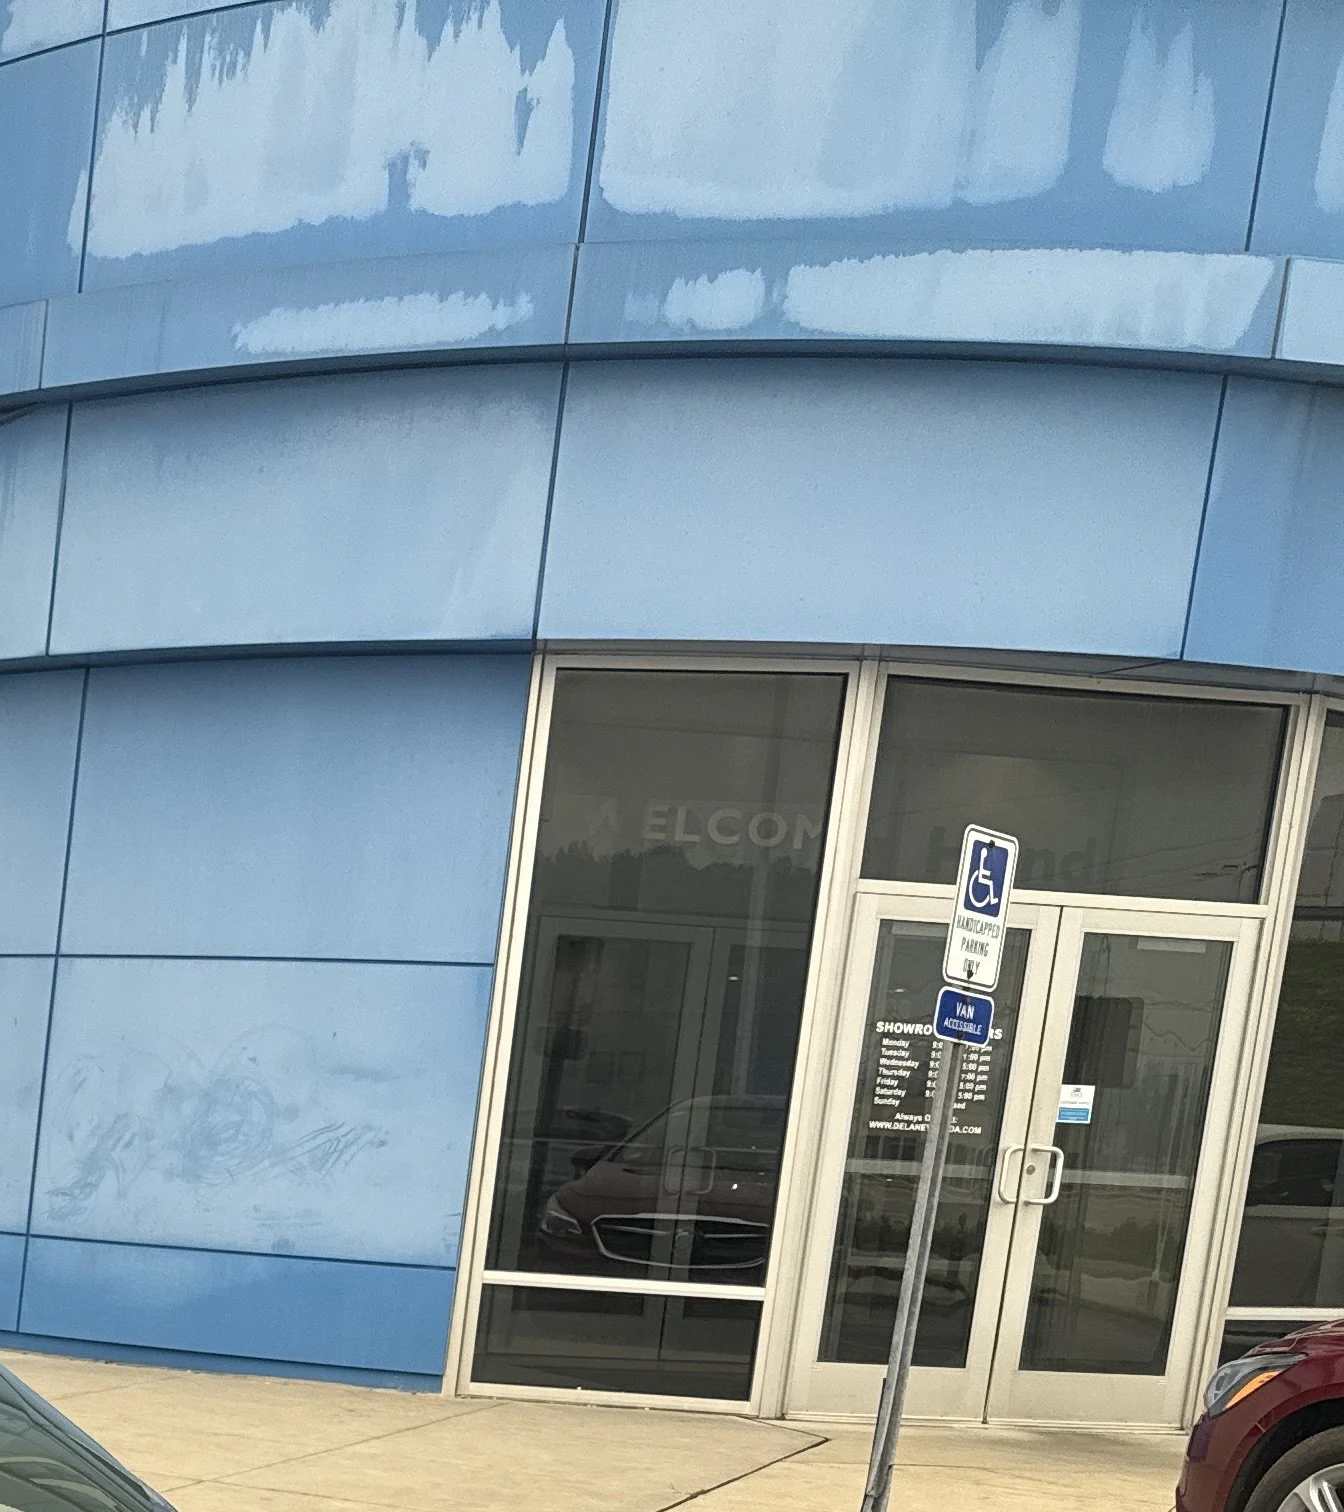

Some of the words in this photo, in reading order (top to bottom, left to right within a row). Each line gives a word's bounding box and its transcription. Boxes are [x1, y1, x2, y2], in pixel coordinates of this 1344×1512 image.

[956, 915, 1000, 939] HANDICAPPED
[960, 937, 990, 957] PARKING
[955, 1002, 975, 1020] VAN
[943, 1017, 983, 1036] ACCESSIBLE
[882, 1038, 910, 1049] Monday
[881, 1048, 910, 1059] Tuesday
[879, 1058, 920, 1070] Wednesday
[878, 1067, 911, 1079] Thursday
[876, 1077, 899, 1087] Friday
[875, 1087, 906, 1098] Saturday
[873, 1096, 900, 1107] Sunday
